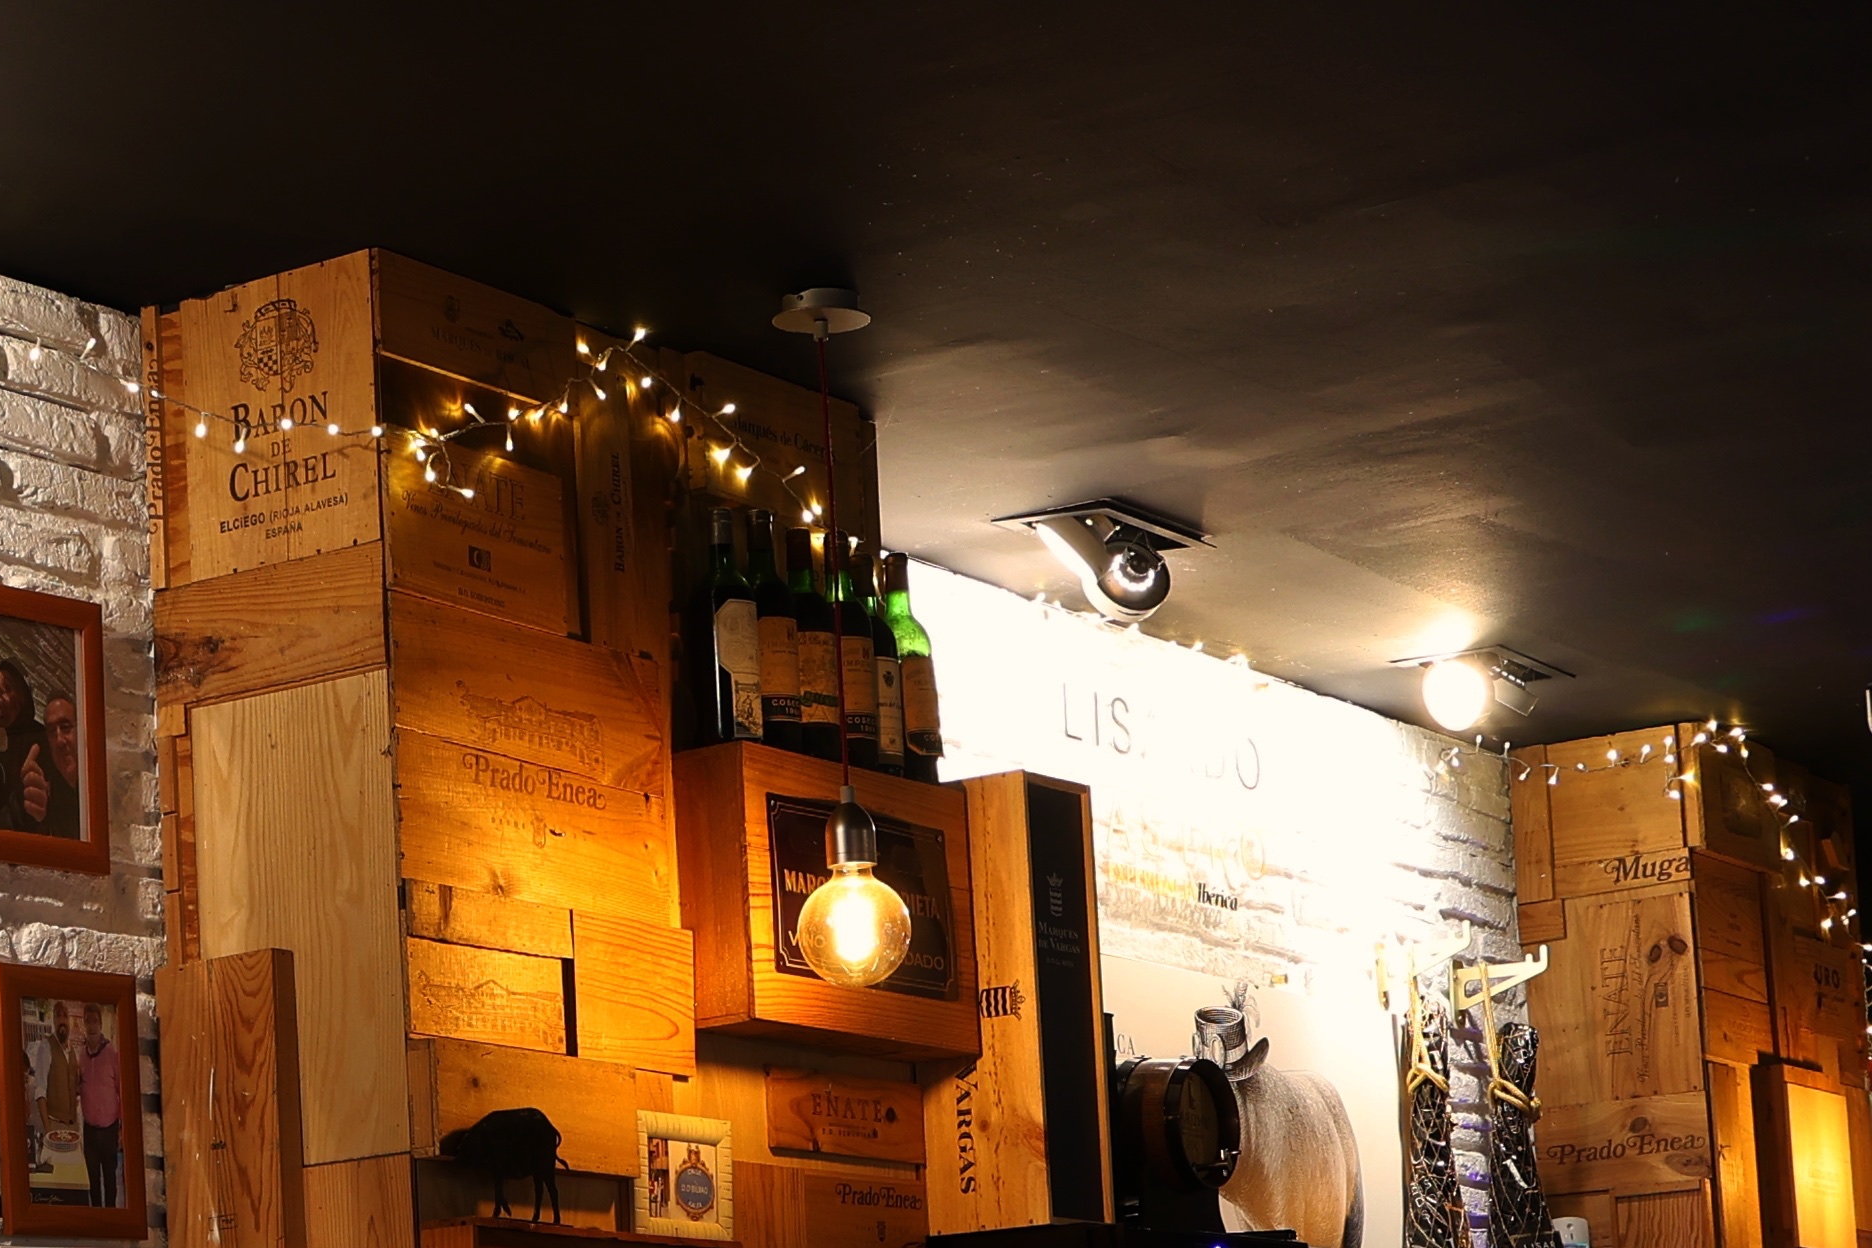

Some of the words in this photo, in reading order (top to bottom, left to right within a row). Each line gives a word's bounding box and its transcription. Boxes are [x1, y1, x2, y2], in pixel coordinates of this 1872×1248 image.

[230, 390, 329, 443] BARON
[270, 437, 292, 458] DE
[146, 444, 165, 536] Prado
[229, 451, 337, 503] CHIREL
[609, 452, 621, 506] CHIREL
[219, 512, 266, 534] ELCIEGO
[304, 492, 349, 514] ALAVESA)
[265, 521, 303, 540] ESPAÑA
[613, 526, 626, 574] BARON
[463, 752, 536, 796] Prado
[535, 768, 607, 811] Enea
[1604, 850, 1691, 886] Muga
[1197, 882, 1238, 911] Ibérica
[1049, 936, 1081, 955] VARGAS
[1599, 945, 1633, 1057] ENATE
[810, 1092, 884, 1123] ENATE
[954, 1056, 981, 1195] VARGAS
[1546, 1138, 1626, 1166] Prado
[1625, 1133, 1706, 1156] Enea
[834, 1182, 880, 1207] Prado
[879, 1186, 923, 1211] Enea
